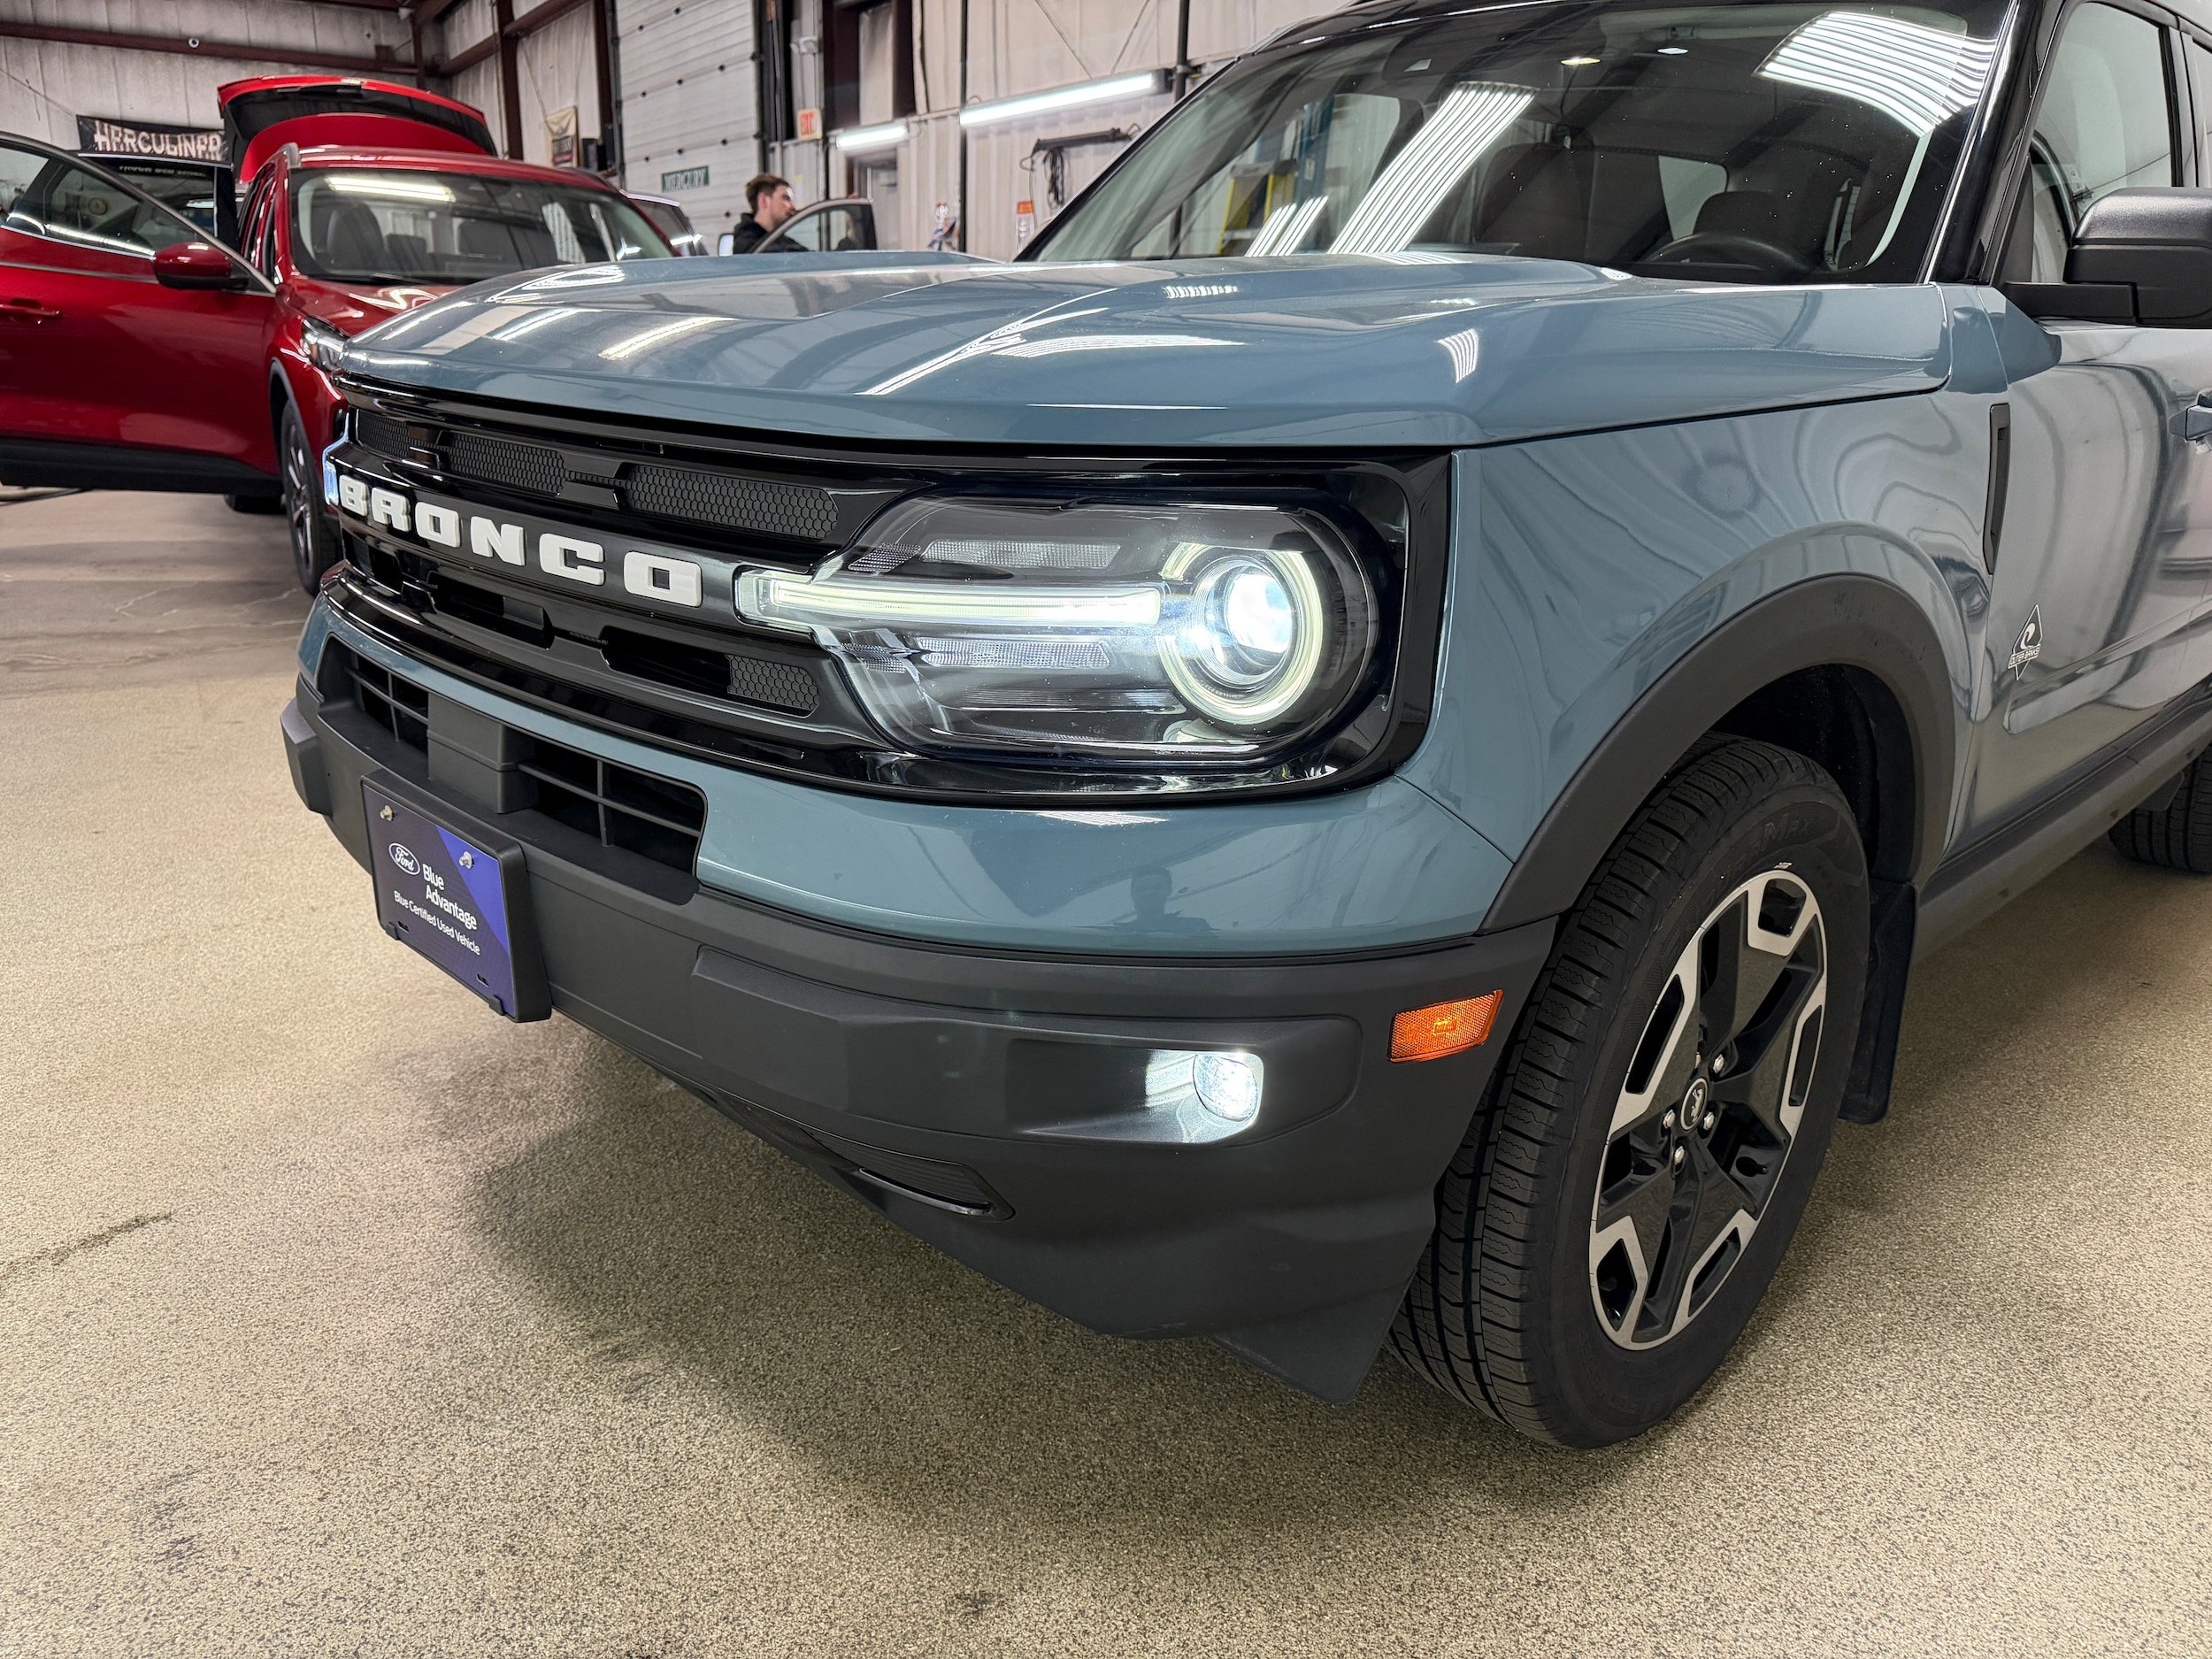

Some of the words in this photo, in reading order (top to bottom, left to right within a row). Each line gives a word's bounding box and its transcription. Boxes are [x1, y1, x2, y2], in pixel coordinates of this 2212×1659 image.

[340, 474, 702, 608] BRONCO
[395, 847, 415, 872] Ford
[423, 863, 444, 890] Blue
[394, 890, 410, 909] Blue
[409, 901, 436, 926] Certified
[436, 918, 455, 939] Used
[454, 929, 480, 956] Vehicle
[426, 885, 477, 930] Advantage
